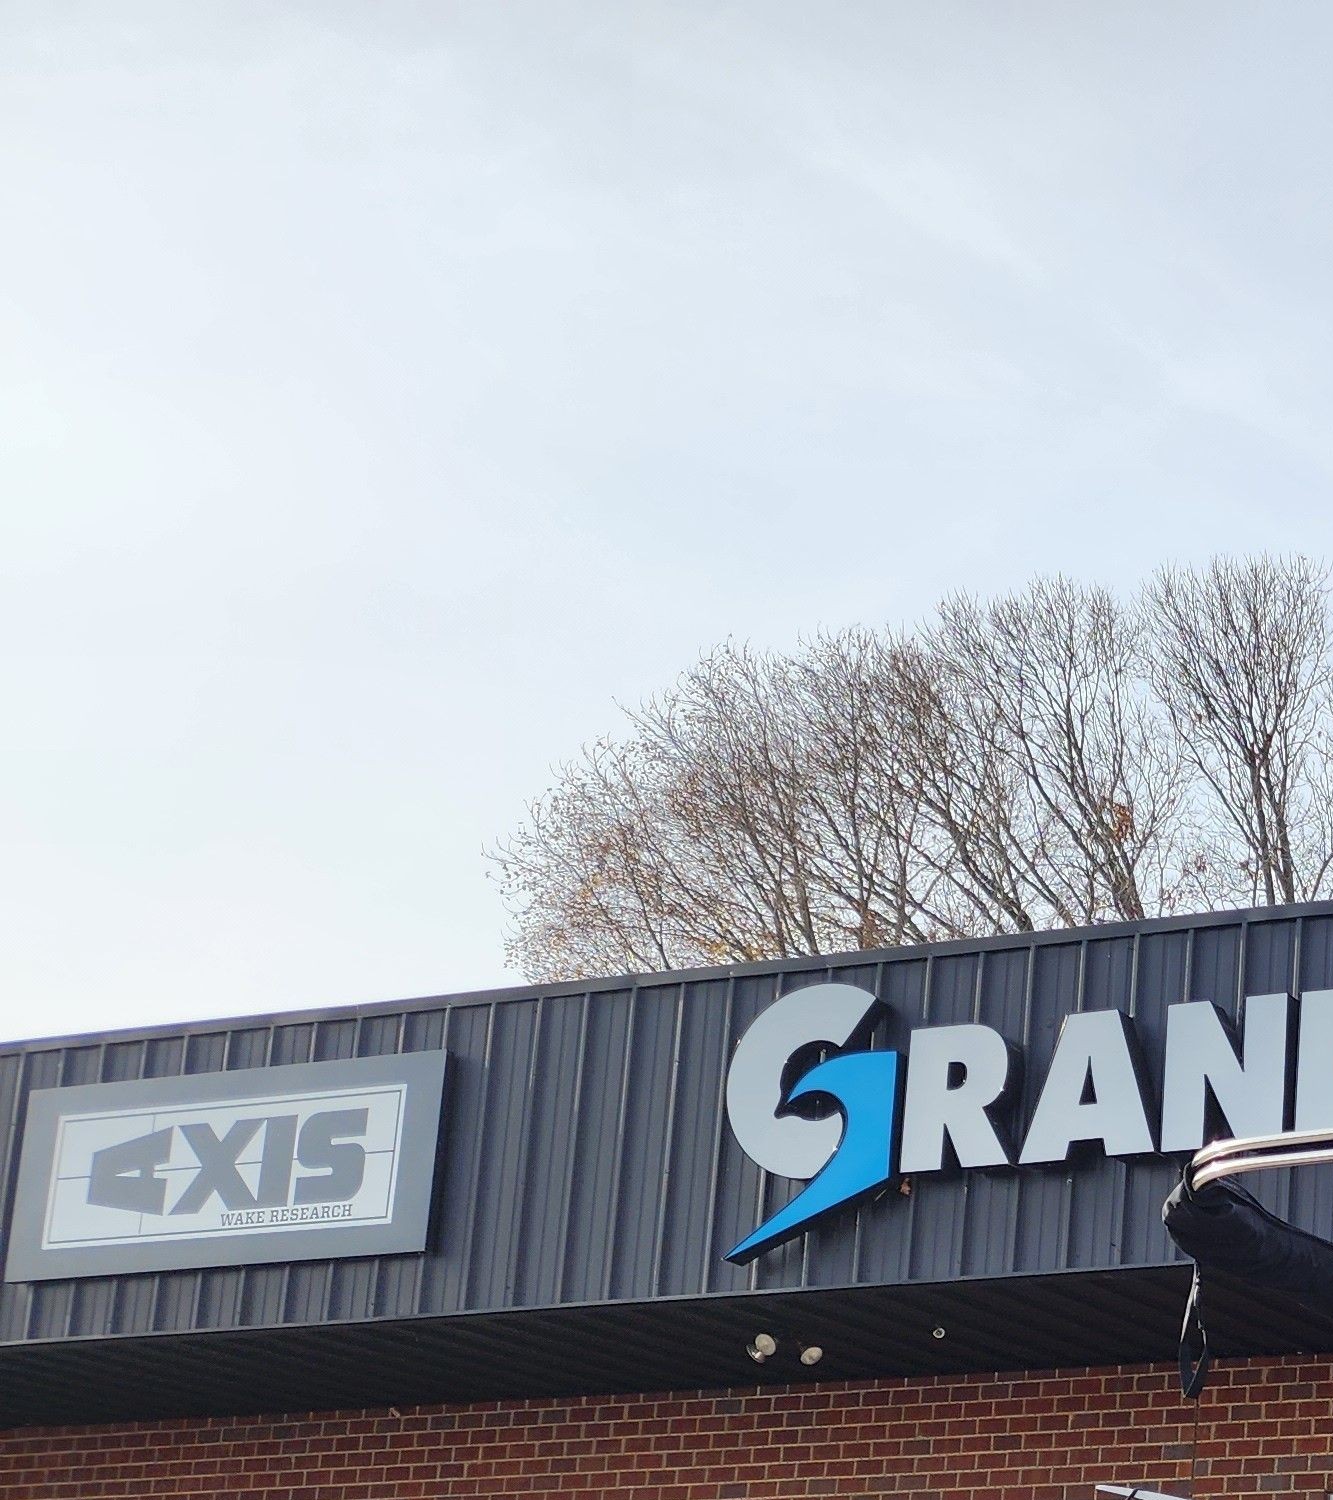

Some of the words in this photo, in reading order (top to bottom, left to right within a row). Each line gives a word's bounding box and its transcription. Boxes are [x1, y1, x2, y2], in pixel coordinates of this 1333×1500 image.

[86, 1106, 369, 1217] AXIS
[220, 1210, 266, 1227] WAKE
[270, 1204, 353, 1223] RESEARCH
